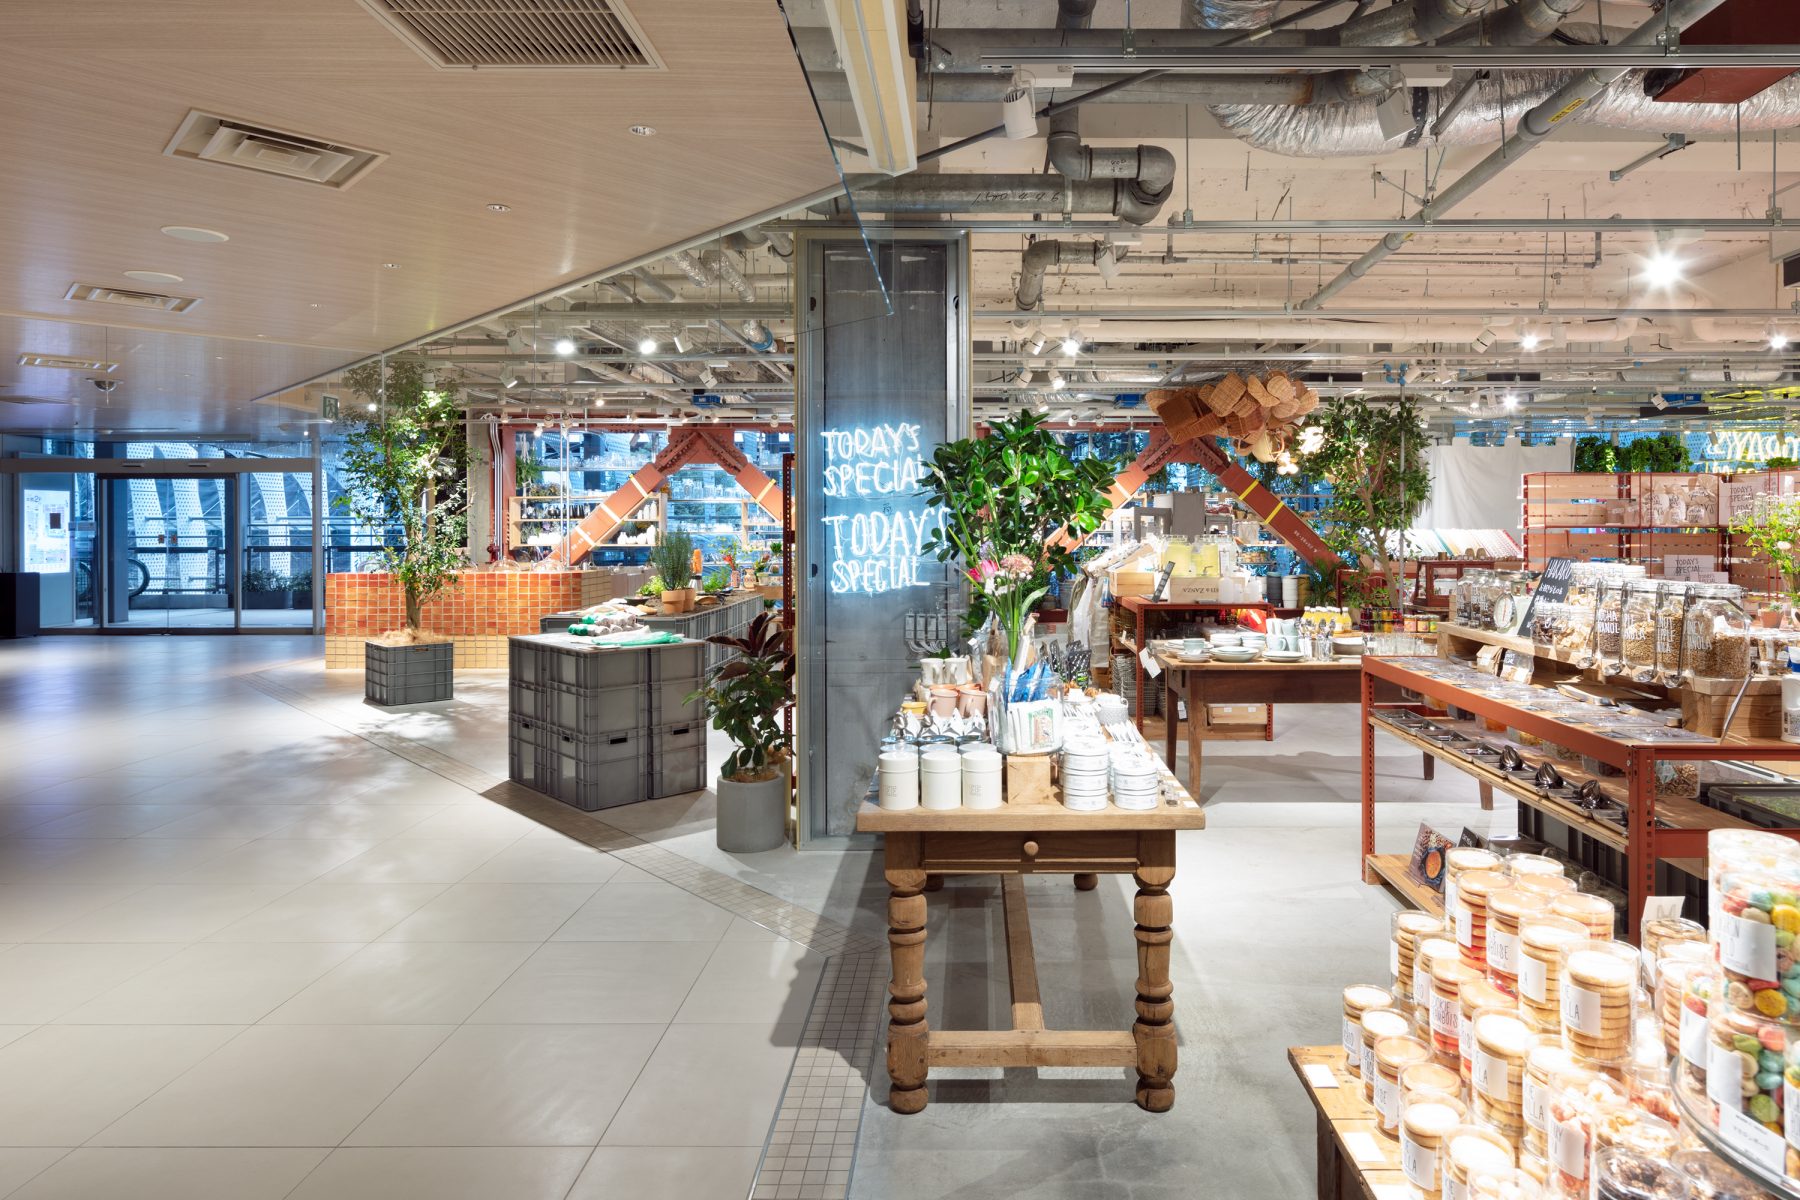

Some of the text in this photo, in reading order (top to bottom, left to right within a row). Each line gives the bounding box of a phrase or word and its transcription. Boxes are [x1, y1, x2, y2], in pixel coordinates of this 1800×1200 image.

[820, 422, 921, 461] TODAY'S
[830, 556, 930, 593] SPECIAL
[1676, 558, 1699, 566] TODAY'S
